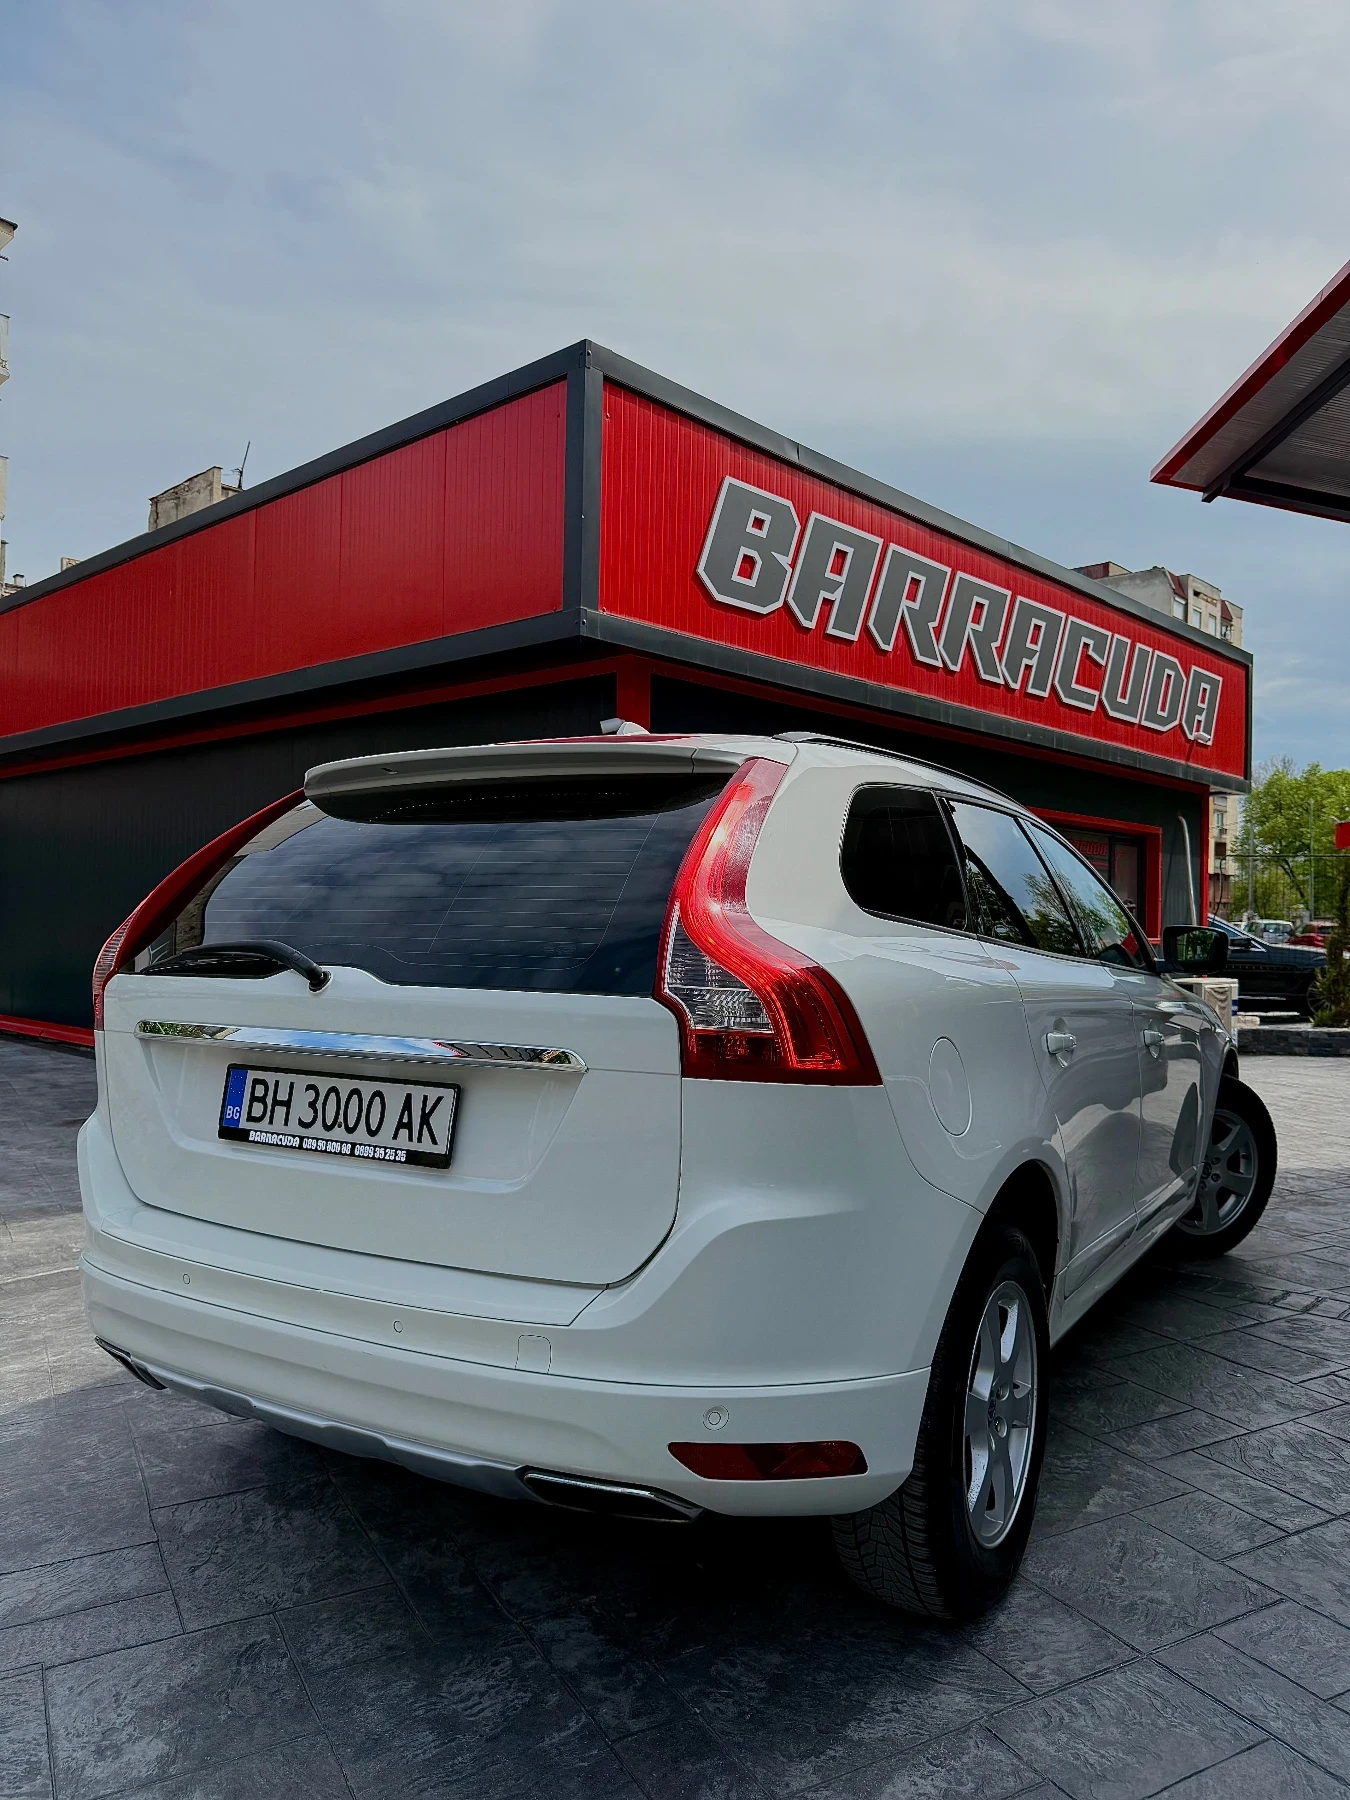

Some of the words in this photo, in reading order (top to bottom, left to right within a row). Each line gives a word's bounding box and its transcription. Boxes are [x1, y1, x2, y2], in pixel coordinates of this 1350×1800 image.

[696, 475, 1223, 746] BARRACUDA
[225, 1105, 240, 1120] BG
[246, 1078, 295, 1126] BH
[298, 1083, 386, 1138] 3000
[391, 1092, 445, 1145] AK
